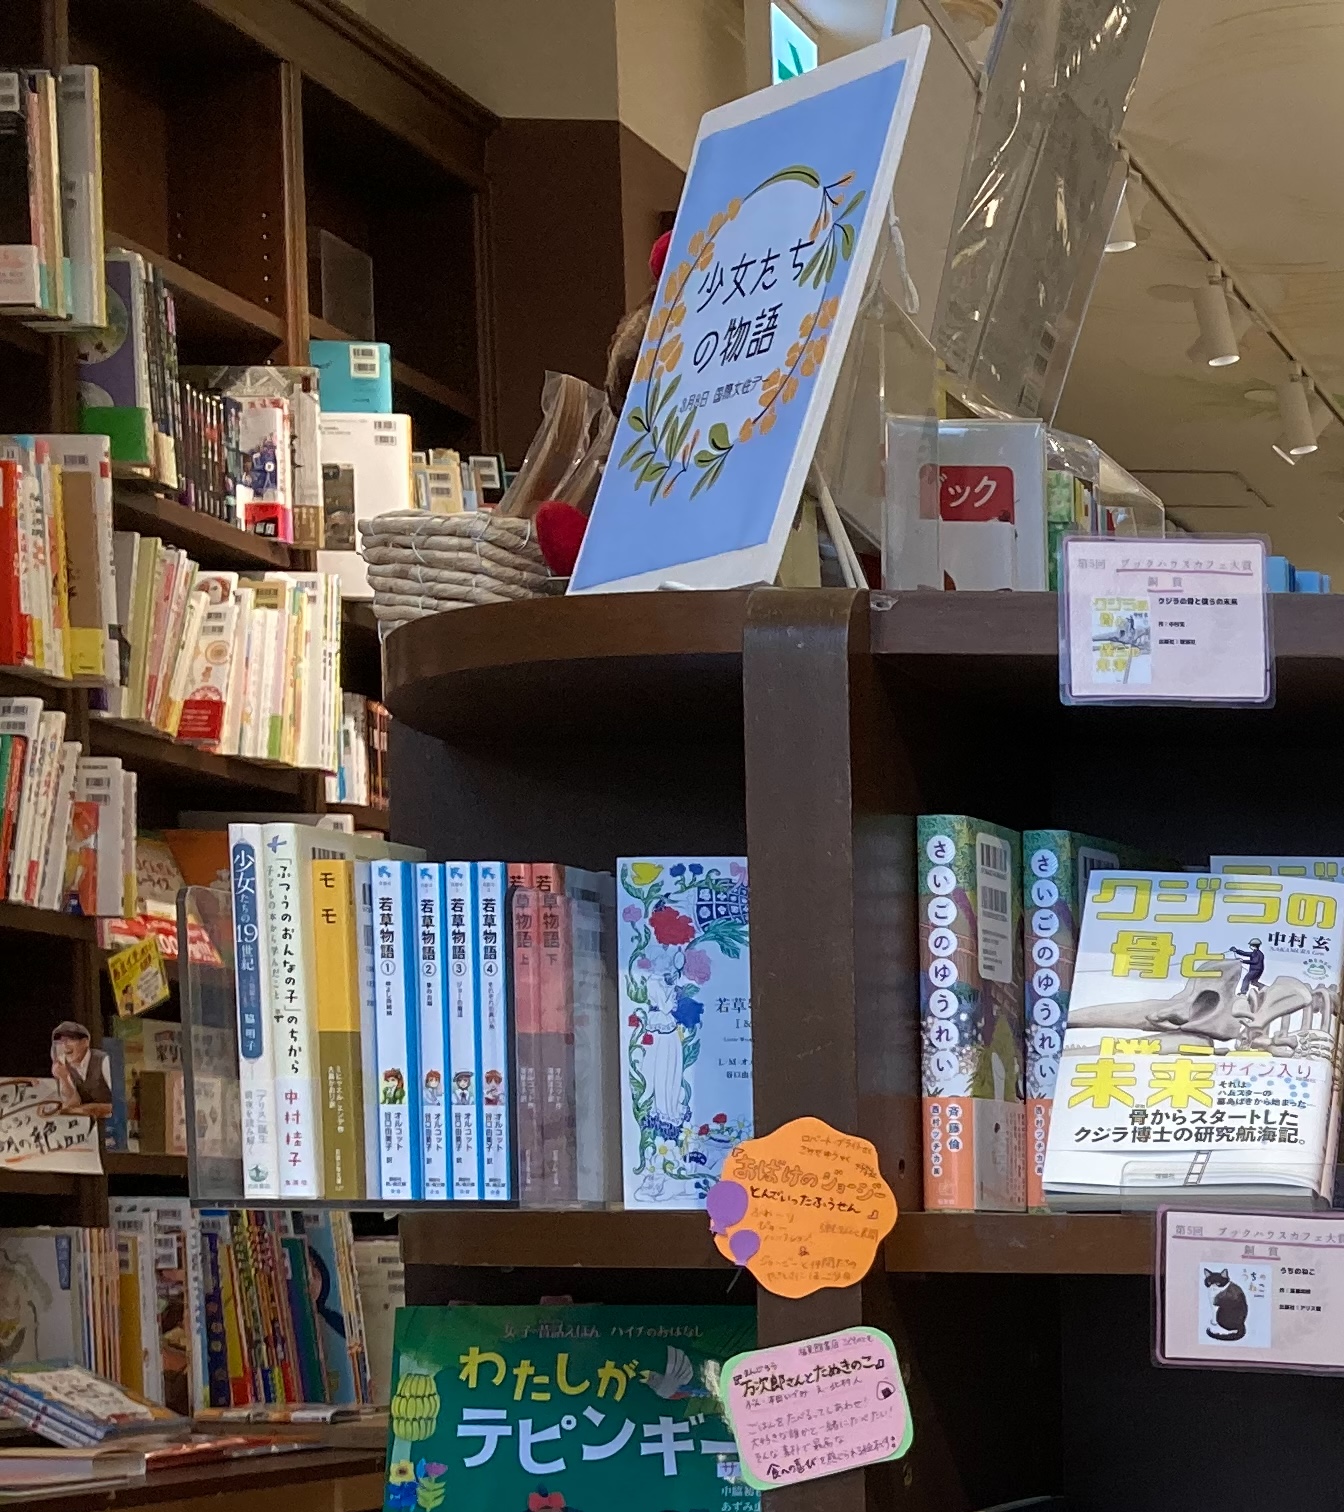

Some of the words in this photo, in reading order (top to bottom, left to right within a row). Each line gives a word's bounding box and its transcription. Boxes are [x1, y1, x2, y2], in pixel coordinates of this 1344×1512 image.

[697, 239, 814, 313] 少女たち
[693, 303, 783, 374] の物語
[1077, 558, 1106, 570] 第5回
[1121, 559, 1253, 572] ブックハウスカフェ大賞
[320, 872, 337, 925] モモ
[1092, 878, 1337, 929] クジラの
[379, 898, 395, 959] 若草物語
[420, 899, 435, 960] 若草物語
[451, 898, 465, 960] 若草物語
[482, 898, 497, 960] 若草物語
[1110, 930, 1225, 980] 骨と
[926, 834, 959, 1079] さいごのゆうれい
[1068, 1058, 1215, 1110] 未来
[1074, 1125, 1306, 1145] クジラ博士の研究航海記。
[1129, 1108, 1299, 1126] 骨からスタートした
[1176, 1225, 1203, 1236] 第5回
[1280, 1267, 1316, 1275] うちのねこ
[458, 1346, 638, 1402] わたしが
